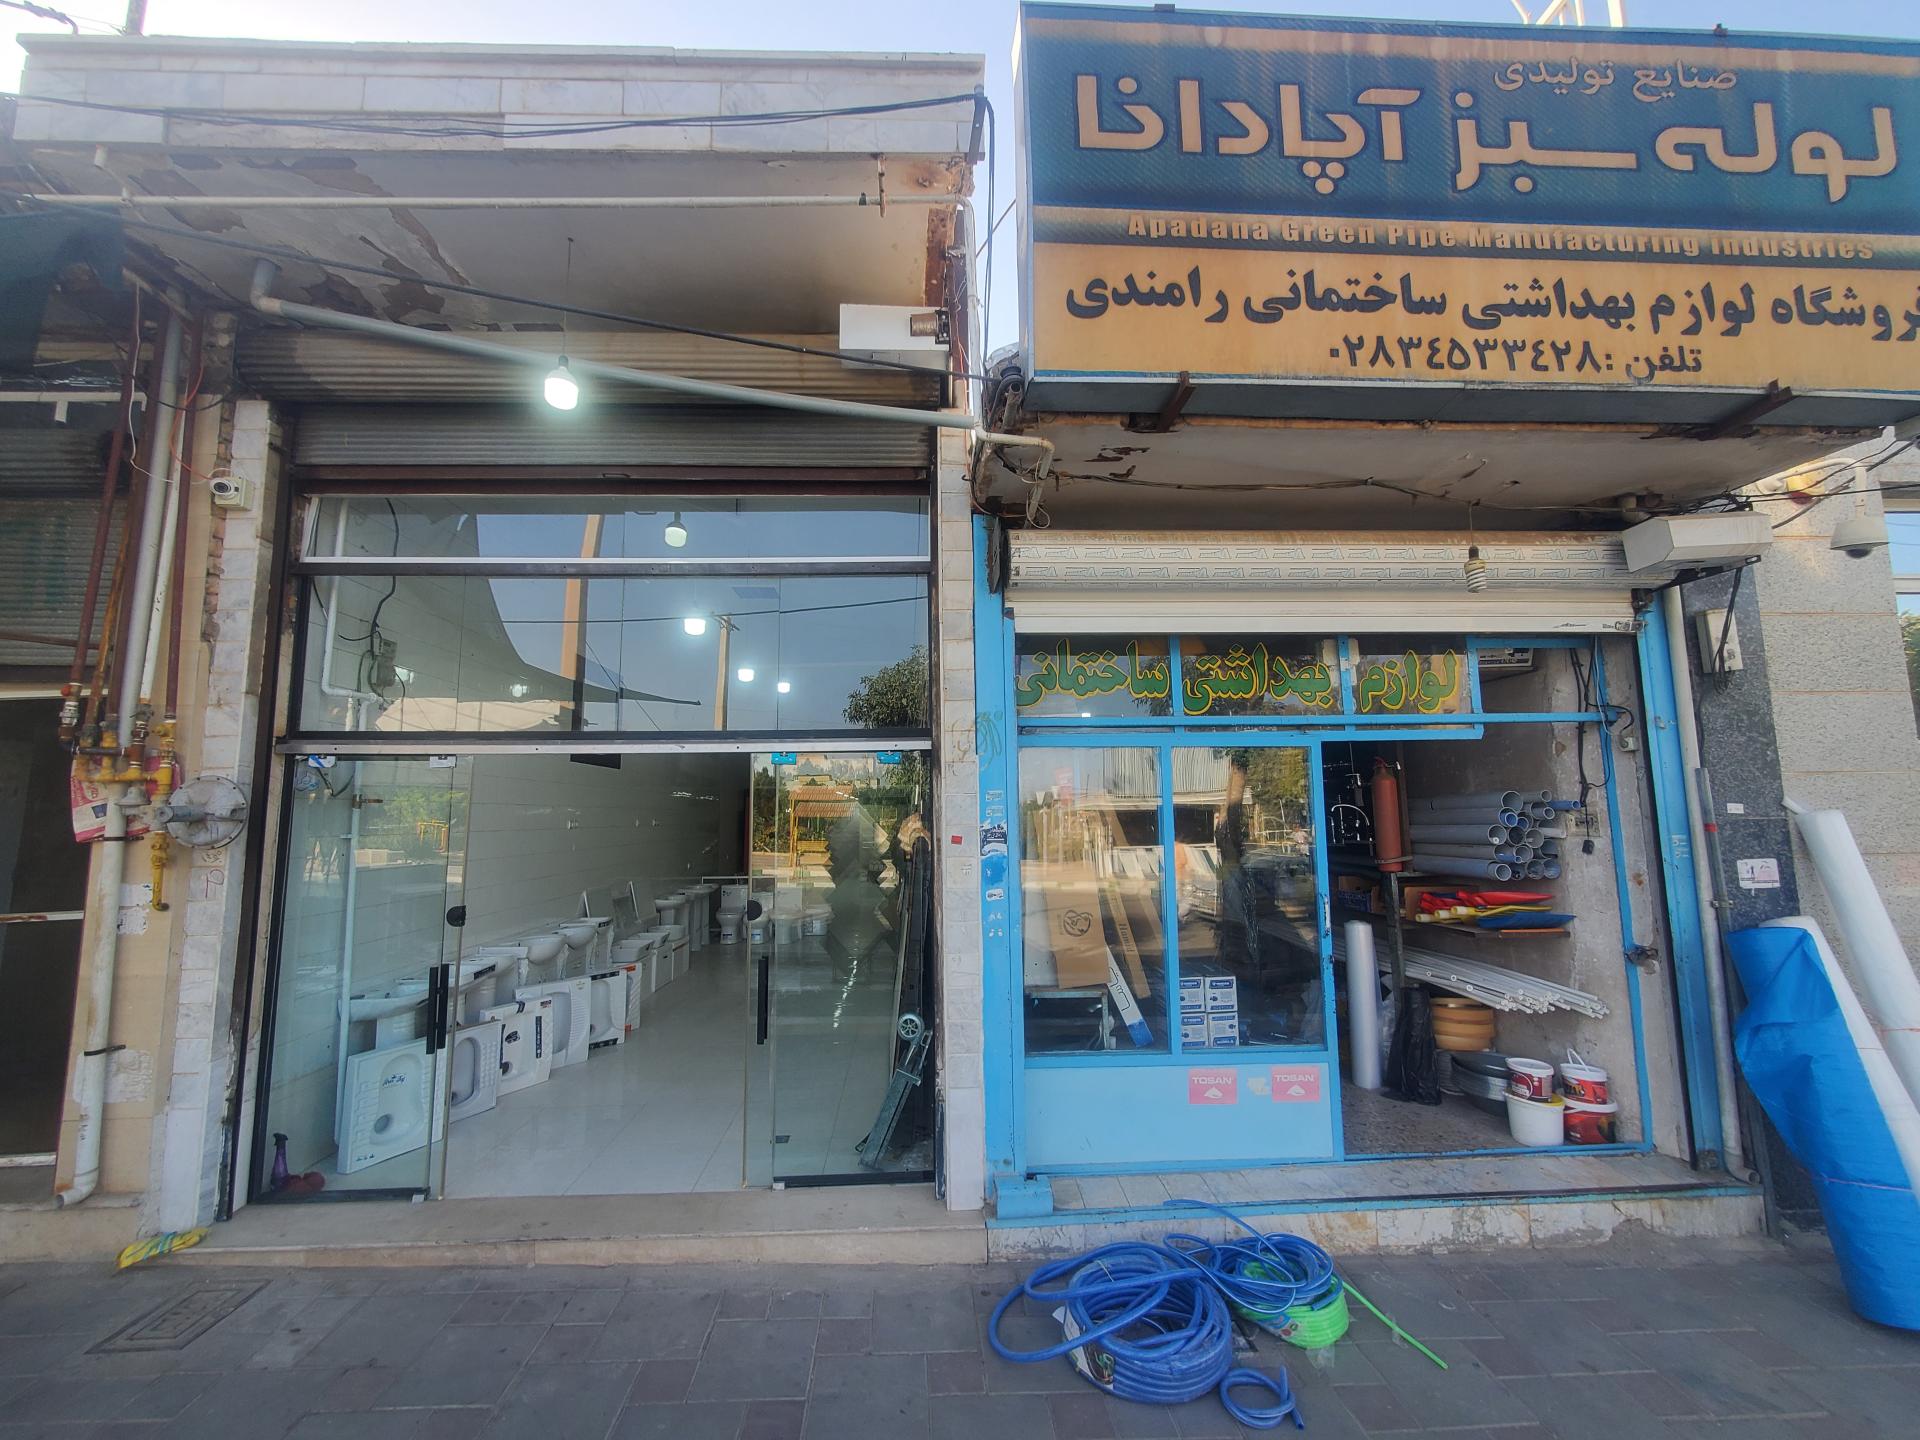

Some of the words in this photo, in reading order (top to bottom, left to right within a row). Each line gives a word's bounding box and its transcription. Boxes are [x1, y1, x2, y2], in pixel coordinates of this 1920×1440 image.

[1493, 56, 1615, 95] تولیدی
[1632, 57, 1738, 102] صنایع
[1075, 74, 1422, 195] آپادانا
[1655, 102, 1897, 203] لوله
[1128, 214, 1270, 241] Apadana
[1281, 219, 1376, 245] Green
[1387, 222, 1457, 248] Pipe
[1468, 226, 1700, 257] Manufacturing
[1066, 265, 1230, 322] رامندی
[1243, 267, 1447, 325] ساختمانی
[1462, 276, 1636, 331] بهداشتی
[1649, 281, 1755, 337] لوازم
[1770, 284, 1920, 342] روشگاه
[1016, 637, 1170, 708] ساختمانی
[1182, 641, 1333, 716] بهداشتی
[1359, 648, 1458, 713] لوازم
[1192, 1076, 1233, 1085] TOSAN
[1274, 1073, 1315, 1083] TOSAN
